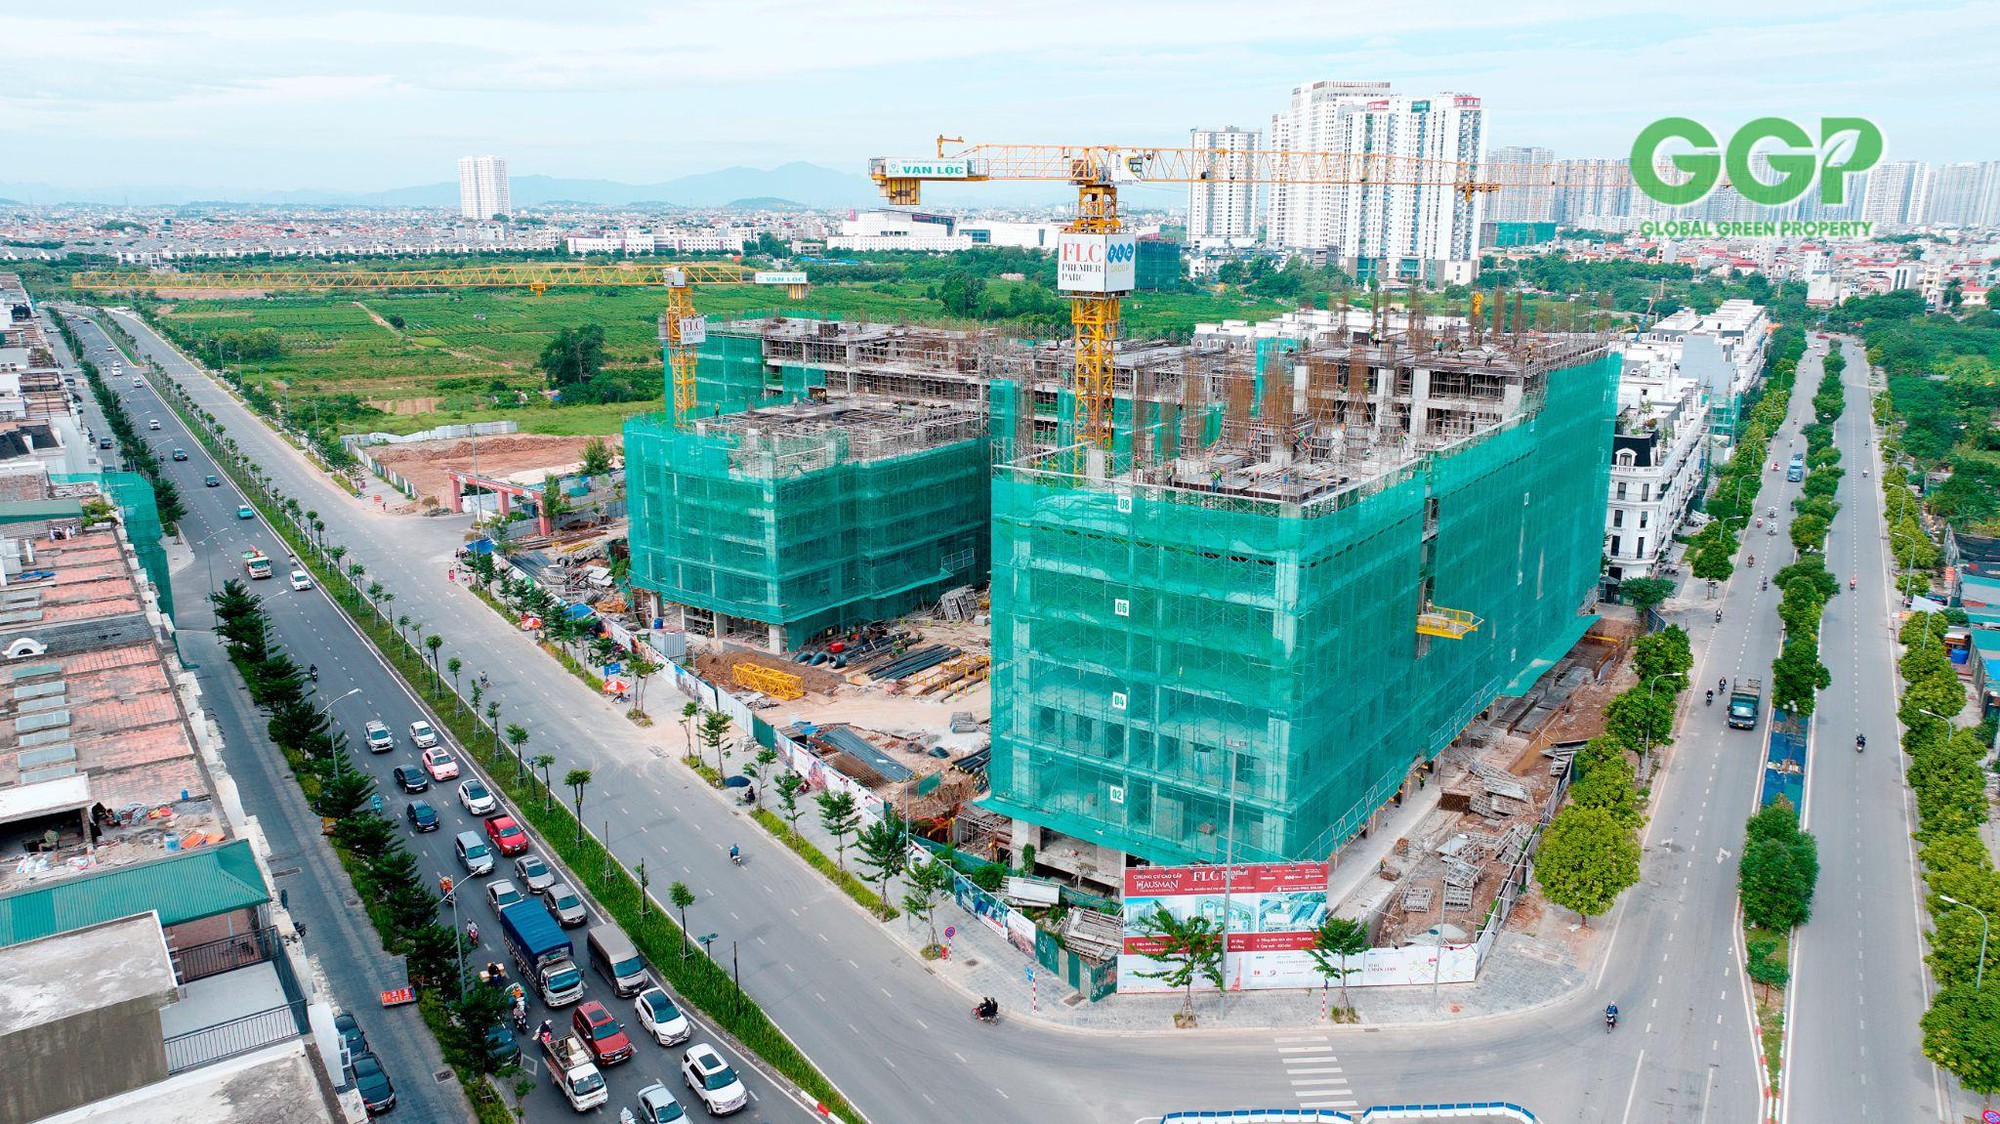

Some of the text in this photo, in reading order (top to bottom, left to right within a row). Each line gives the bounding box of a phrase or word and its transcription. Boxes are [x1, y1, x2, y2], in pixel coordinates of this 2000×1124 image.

[1063, 243, 1102, 263] FLC
[1062, 264, 1102, 273] PREMIER
[1062, 273, 1085, 281] PARC
[683, 320, 702, 331] FLC
[1119, 499, 1130, 510] 08
[1117, 602, 1127, 613] 06
[1114, 695, 1125, 706] 04
[1112, 789, 1122, 800] 02
[1193, 870, 1219, 882] FLC
[1136, 880, 1179, 890] HAUSMAN
